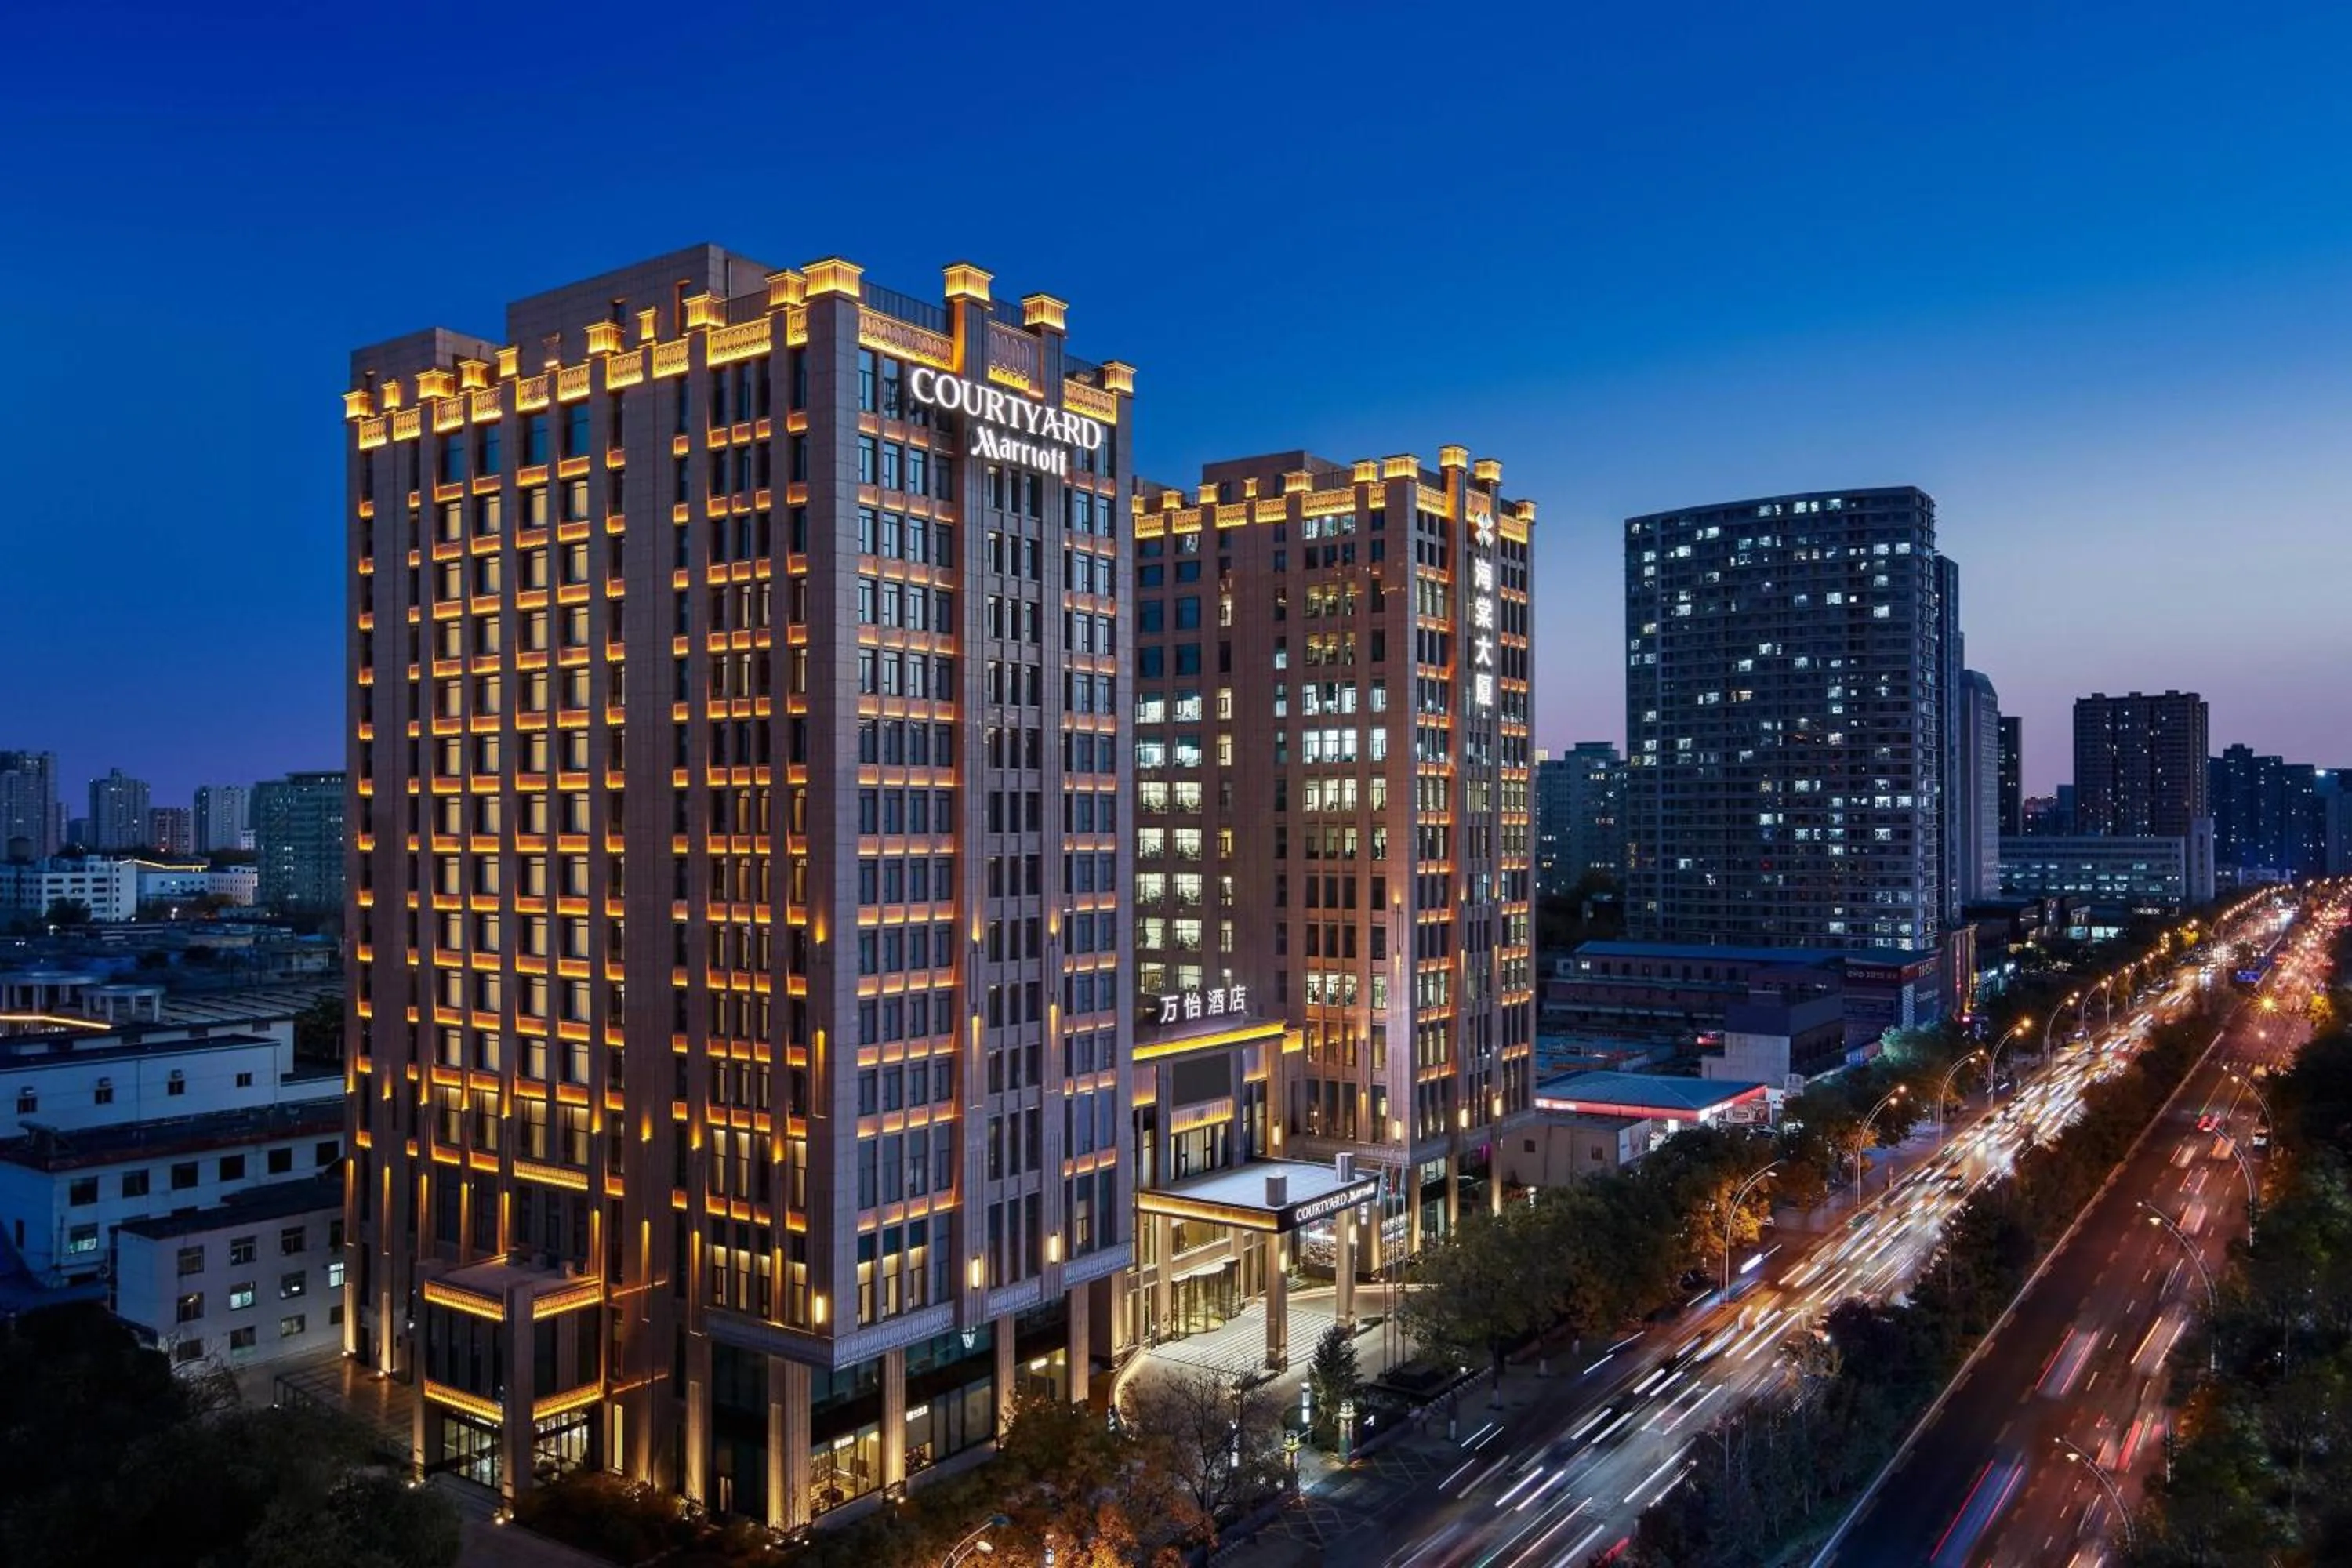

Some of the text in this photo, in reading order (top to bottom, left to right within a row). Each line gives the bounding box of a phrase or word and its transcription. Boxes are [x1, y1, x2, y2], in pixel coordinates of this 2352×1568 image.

[910, 367, 1102, 451] COURTYARD
[971, 426, 1067, 477] Marriott
[1160, 985, 1247, 1023] 万怡酒店
[1295, 1192, 1348, 1221] COURTYARD
